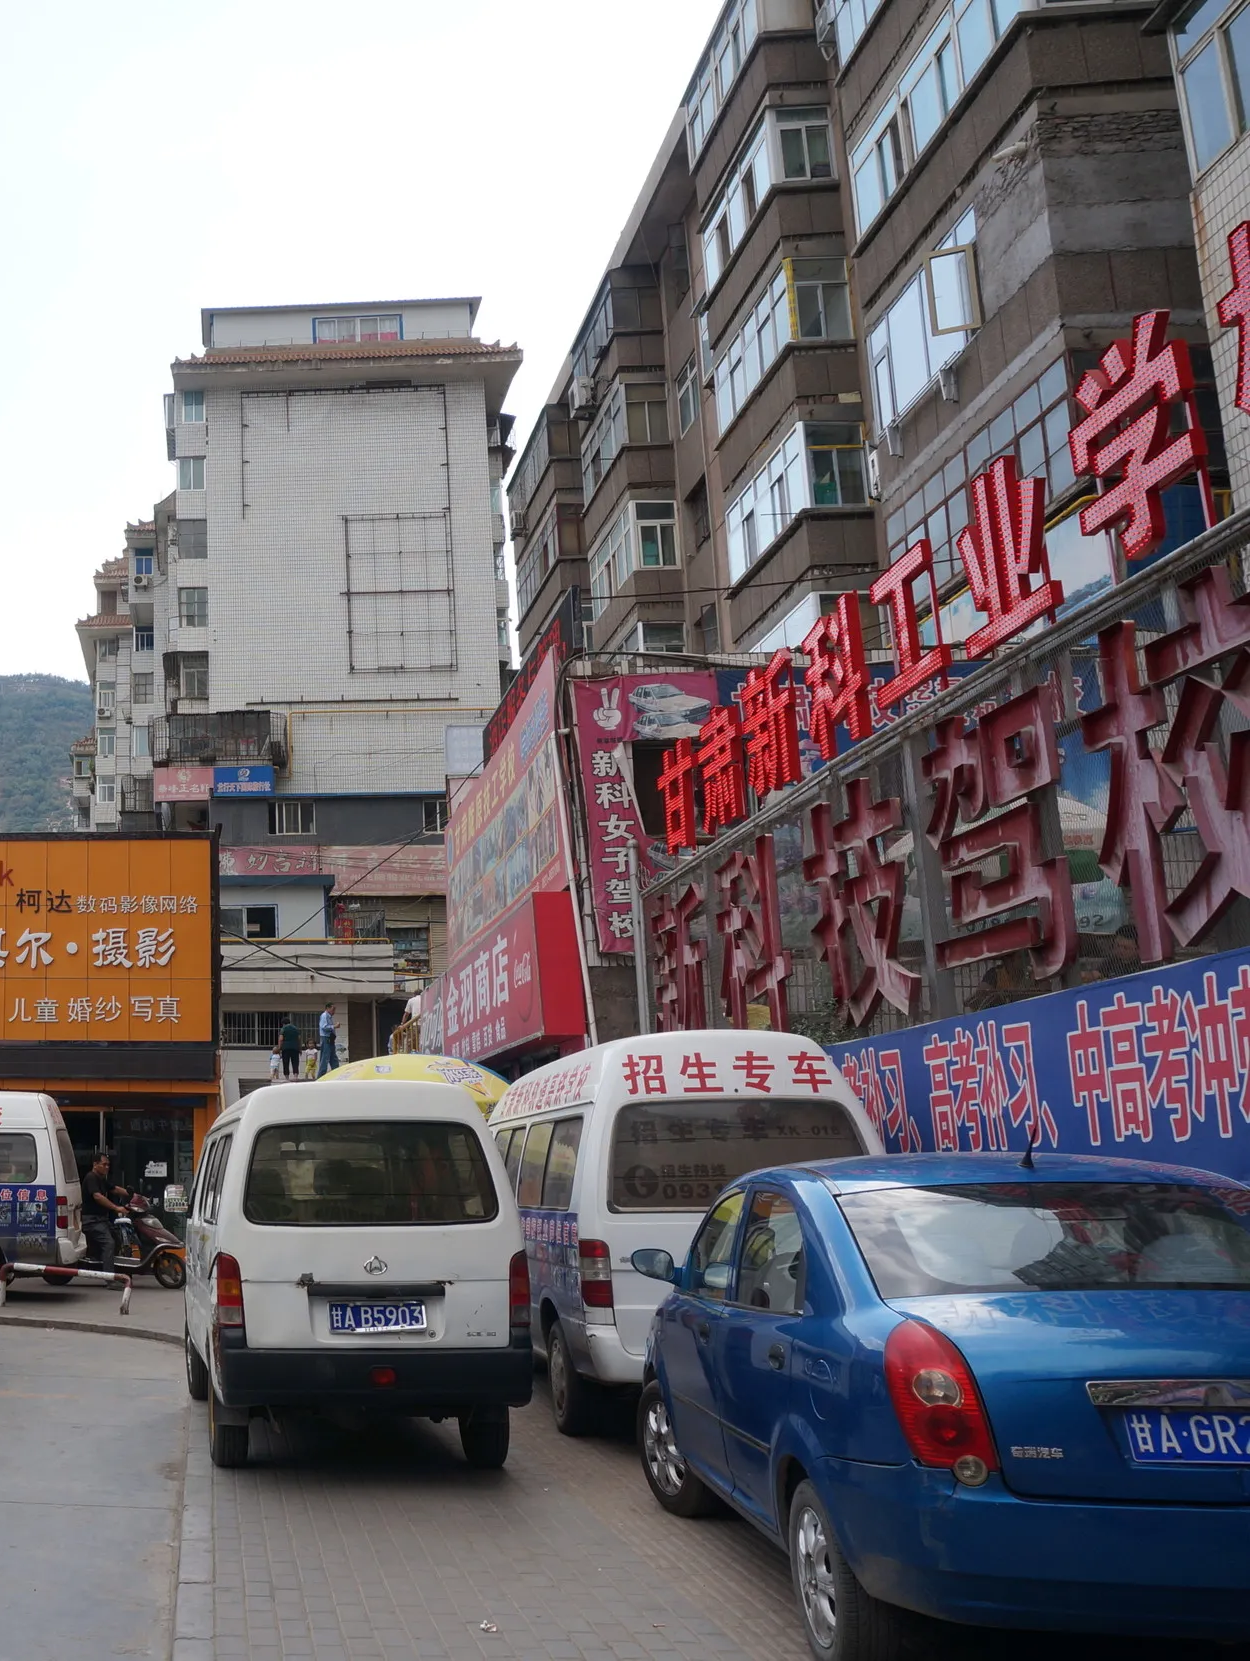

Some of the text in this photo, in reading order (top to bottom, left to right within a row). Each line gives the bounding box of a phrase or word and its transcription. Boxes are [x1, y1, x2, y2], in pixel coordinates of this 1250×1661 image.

[592, 751, 635, 938] 新科女子驾校
[15, 888, 199, 914] 柯达 数码影像网络
[446, 934, 510, 1037] 金羽商店
[8, 996, 59, 1024] 儿童
[67, 996, 122, 1024] 婚纱
[130, 995, 181, 1024] 写真
[495, 1016, 506, 1042] 食品
[622, 1051, 833, 1095] 招生专车
